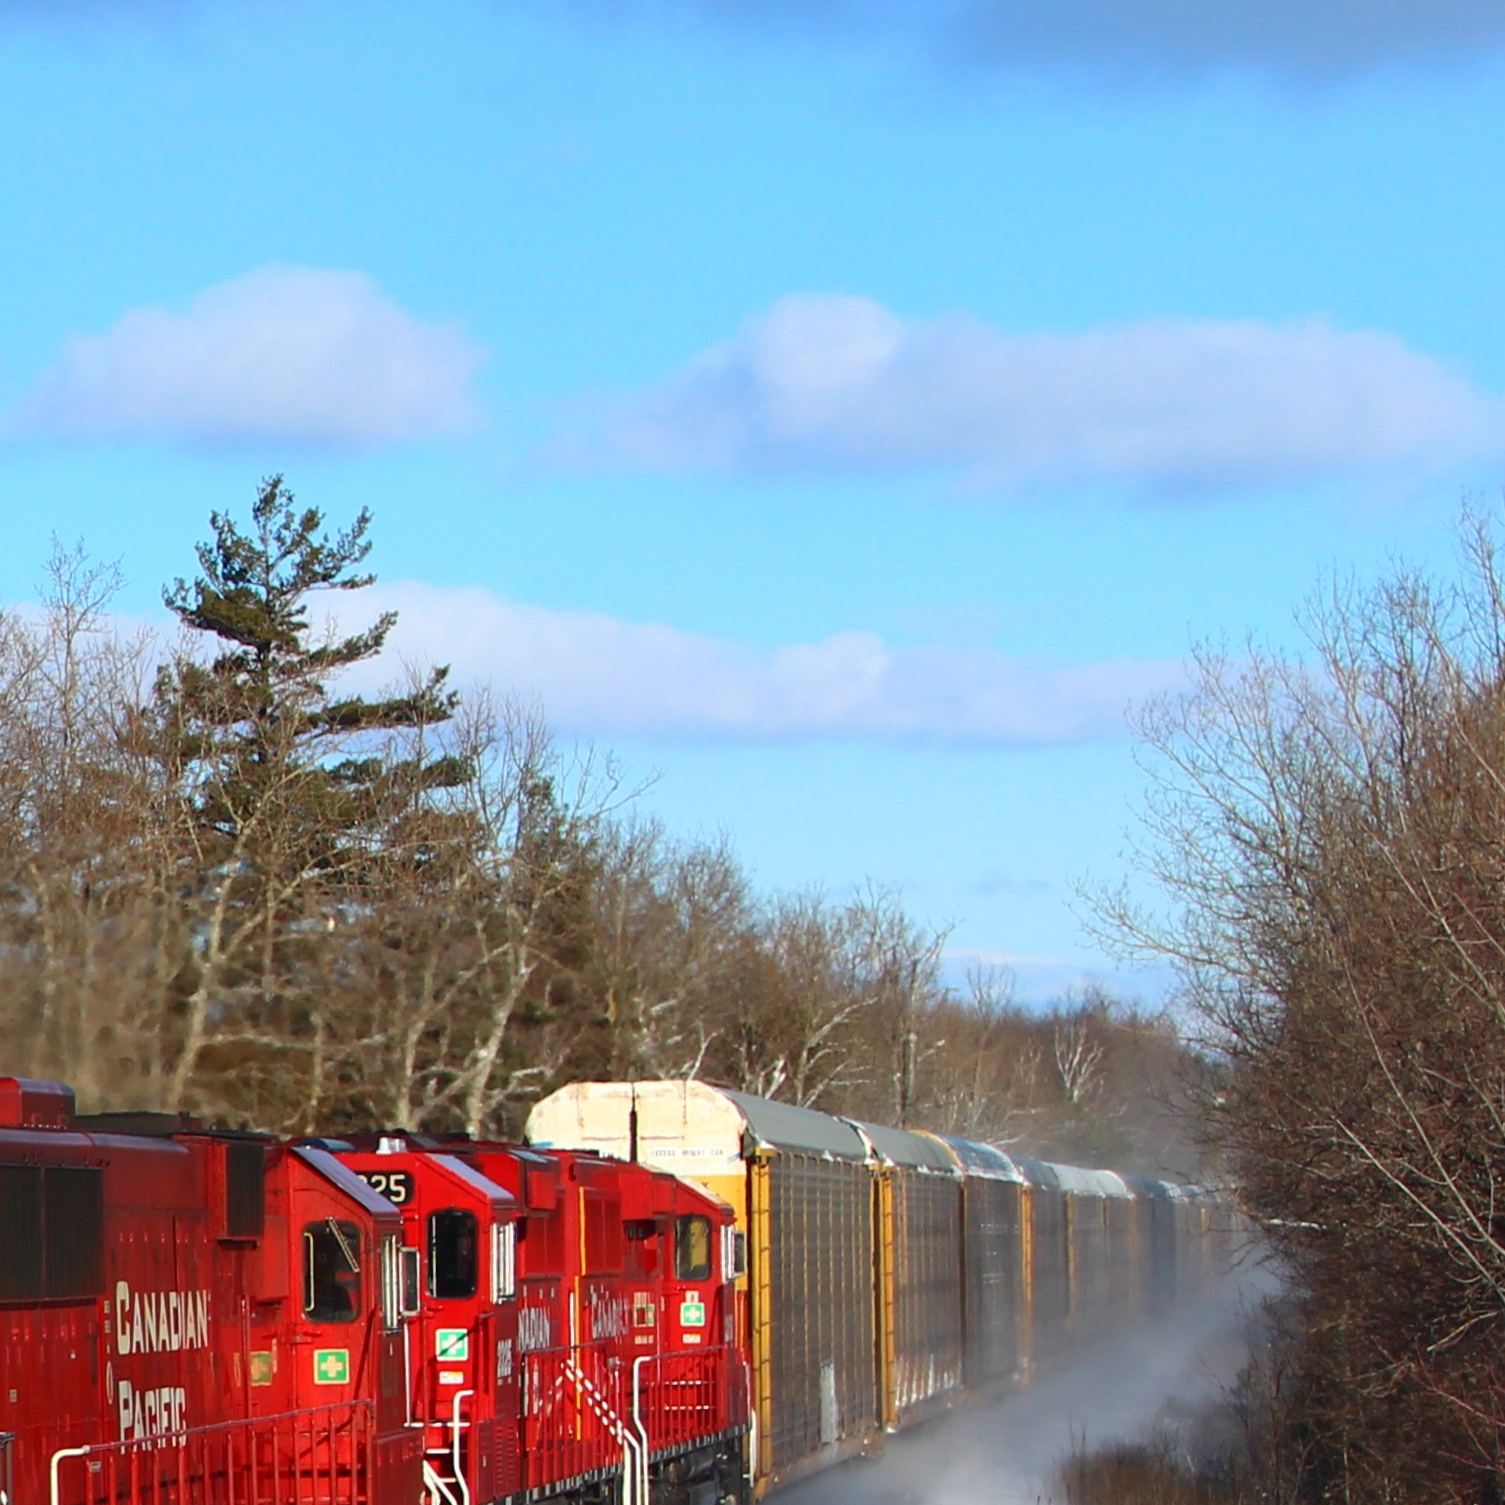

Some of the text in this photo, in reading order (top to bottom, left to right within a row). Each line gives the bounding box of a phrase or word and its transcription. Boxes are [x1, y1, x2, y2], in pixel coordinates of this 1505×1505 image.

[357, 1174, 406, 1203] 25
[115, 1280, 209, 1355] CANADIAN
[118, 1380, 188, 1456] PACIFIC
